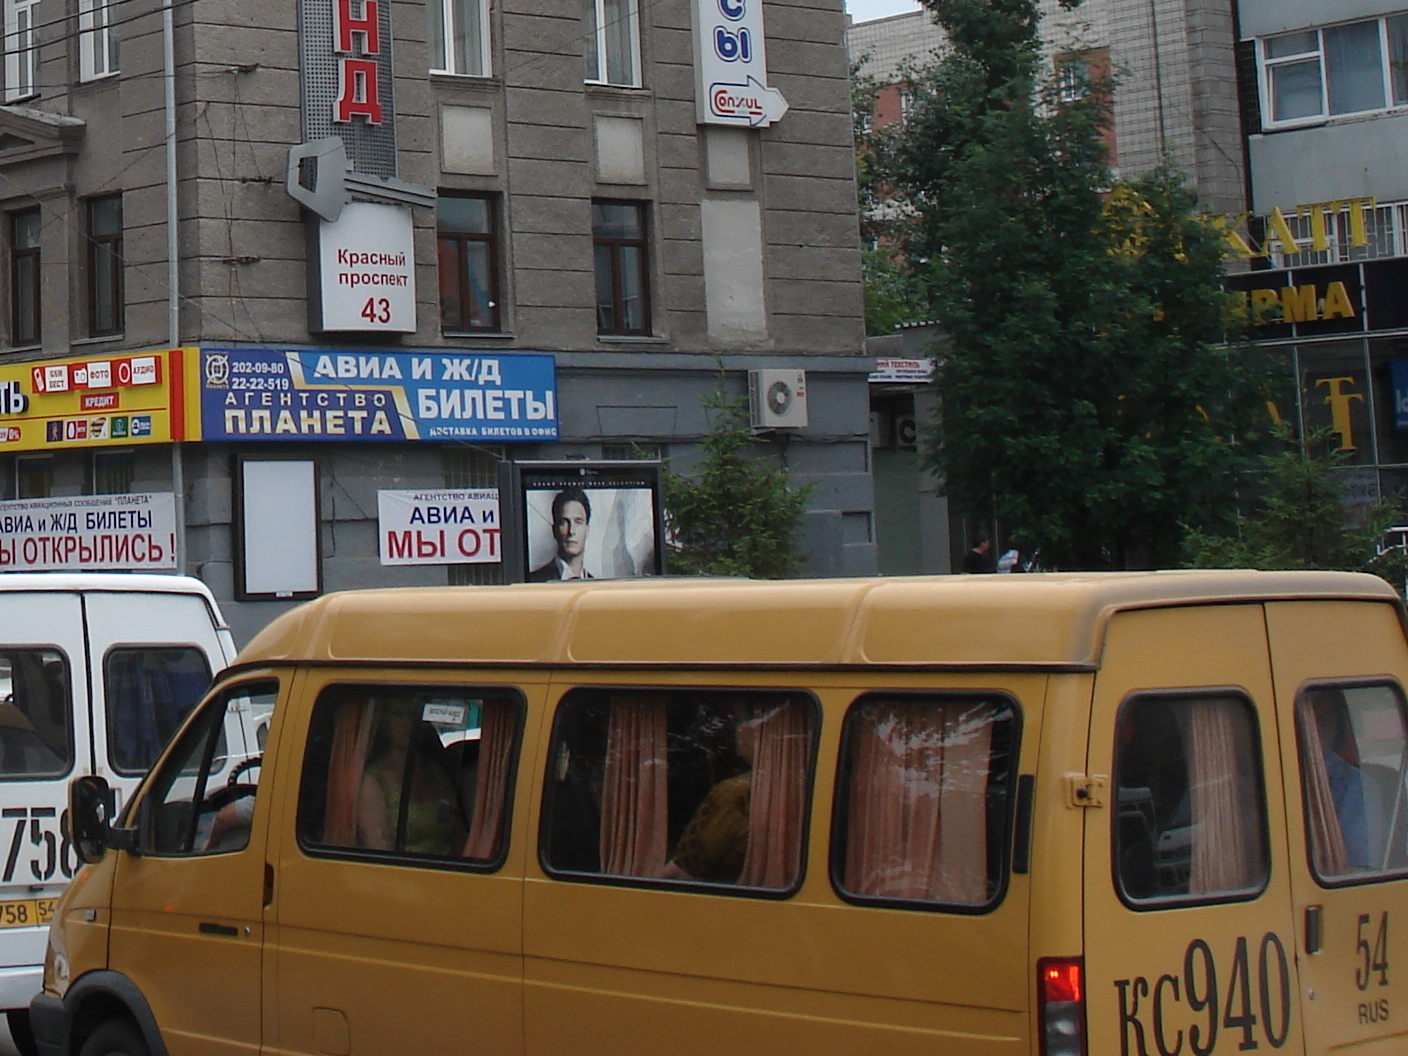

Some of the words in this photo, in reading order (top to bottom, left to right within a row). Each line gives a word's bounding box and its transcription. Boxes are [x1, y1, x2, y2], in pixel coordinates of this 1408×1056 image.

[337, 249, 406, 268] Красный
[338, 272, 409, 288] проспект
[361, 297, 391, 324] 43
[90, 370, 109, 380] ФОТО
[133, 365, 154, 375] АУДИО
[232, 362, 284, 374] 202-09-80
[313, 355, 403, 379] АВИА
[411, 358, 433, 380] И
[441, 358, 502, 386] Ж/Д
[231, 378, 289, 390] 22-22-519
[85, 395, 114, 408] КРЕДИТ
[224, 391, 386, 407] АГЕНТСТВО
[417, 388, 555, 420] БИЛЕТЫ
[224, 408, 393, 435] ПЛАНЕТА
[429, 426, 478, 437] ДОСТАВКА
[481, 426, 523, 436] БИЛЕТОВ
[531, 427, 558, 436] ОФИС
[413, 493, 466, 502] АГЕНТСТВО
[38, 519, 46, 532] и
[50, 512, 78, 534] Ж/Д
[86, 509, 152, 531] БИЛЕТЫ
[409, 506, 476, 525] АВИА
[482, 509, 495, 524] и
[23, 533, 164, 565] ОТКРЫЛИСЬ
[387, 529, 446, 559] МЫ
[458, 528, 501, 558] ОТ
[1355, 910, 1389, 991] 54
[1358, 1000, 1390, 1025] RUS
